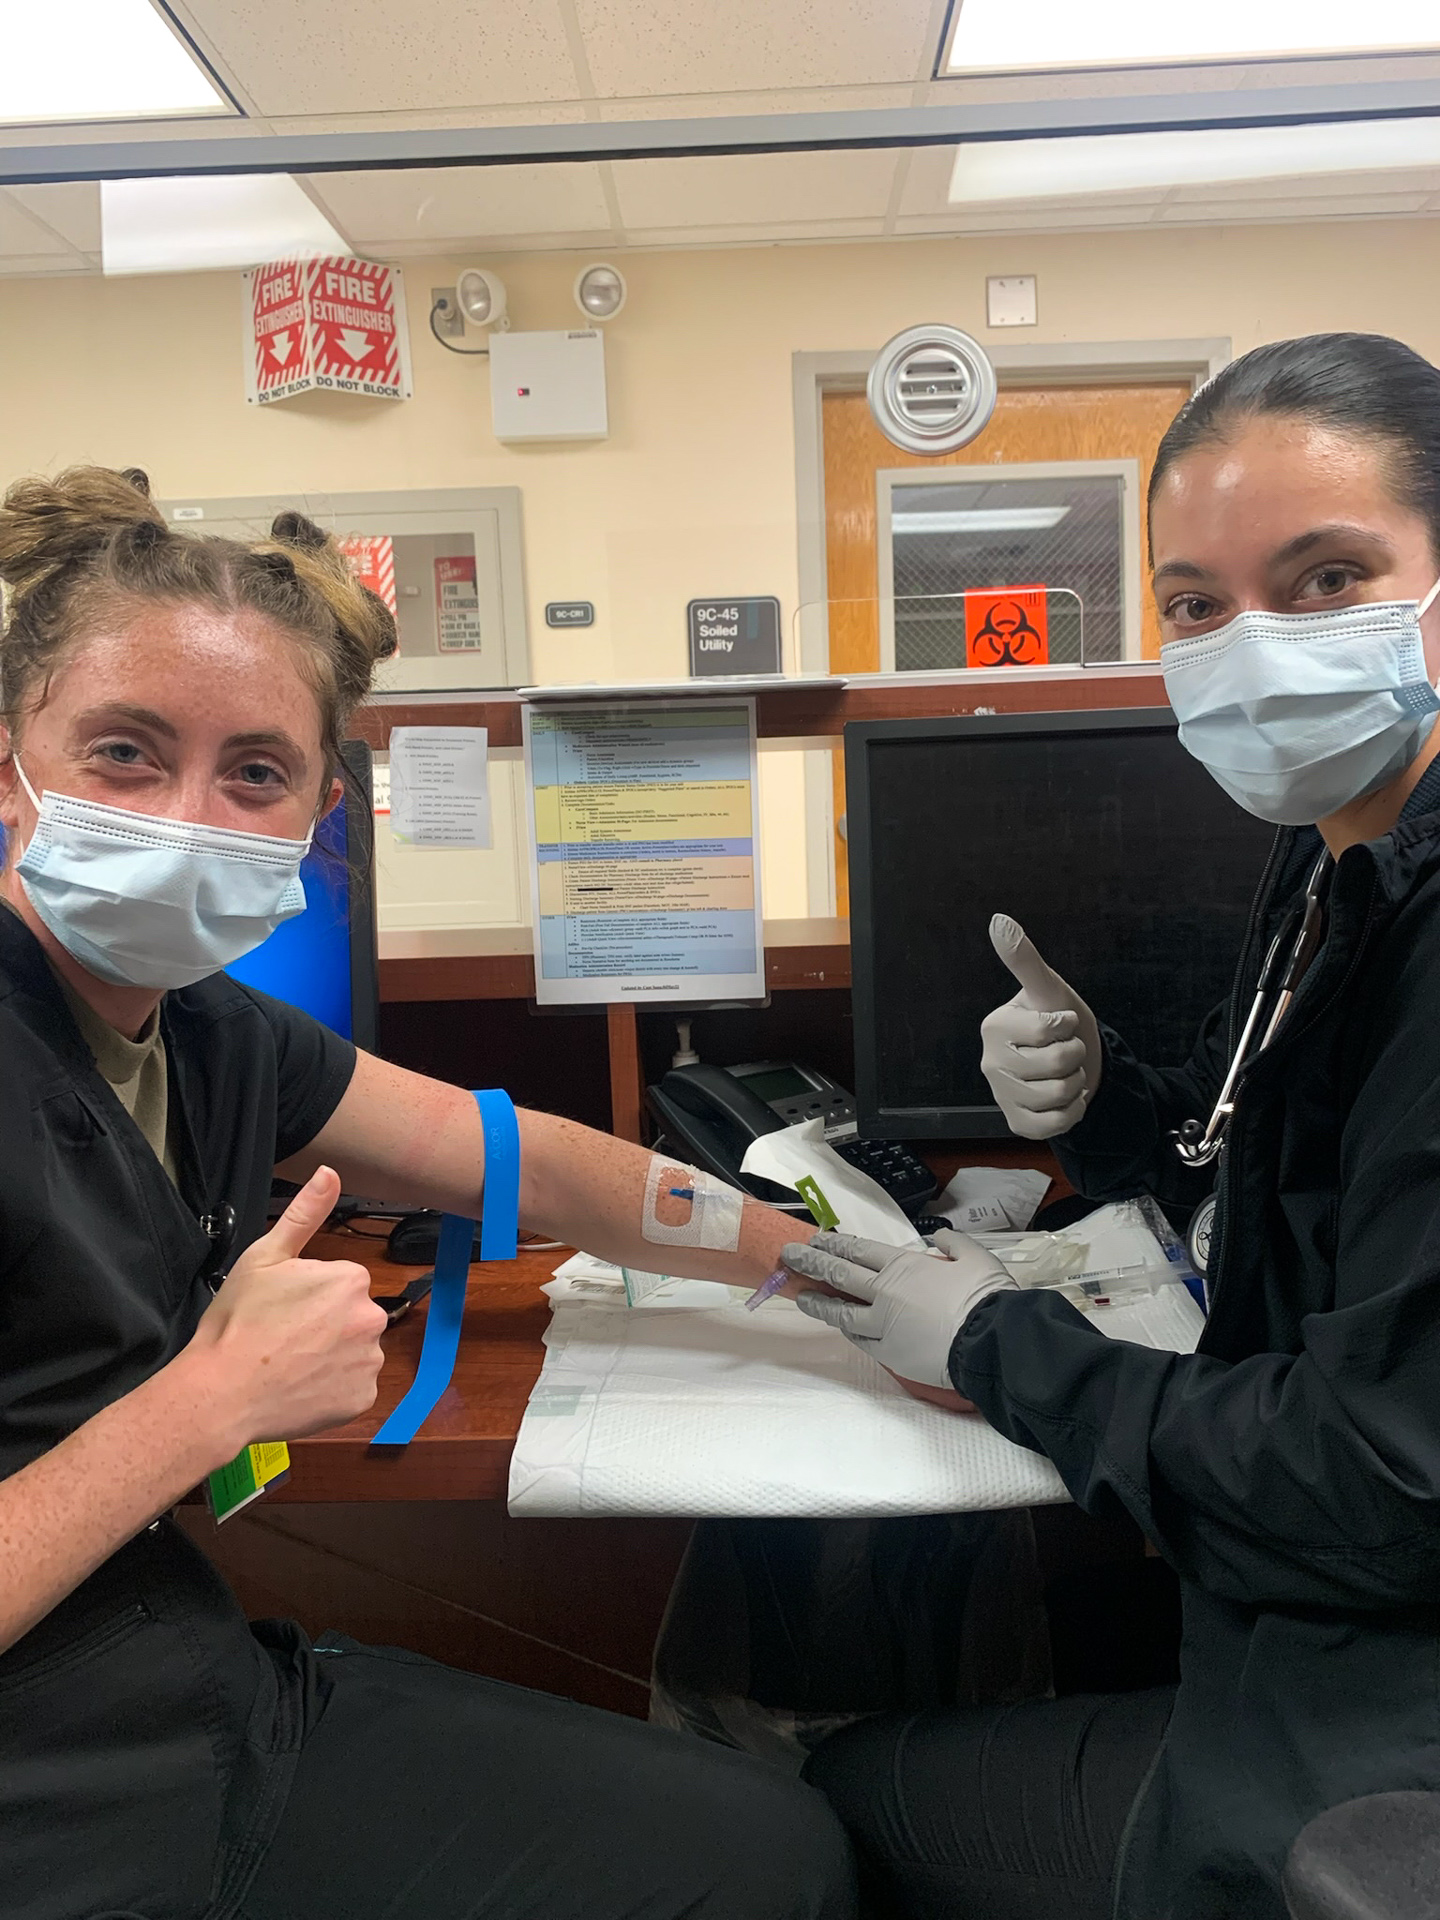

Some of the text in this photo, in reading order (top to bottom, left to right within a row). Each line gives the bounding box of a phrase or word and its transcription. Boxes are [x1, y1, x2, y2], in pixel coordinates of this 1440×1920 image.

[263, 273, 294, 307] FIRE
[325, 272, 377, 304] FIRE
[255, 299, 305, 337] EXTINGUISHER
[313, 299, 393, 332] EXTINGUISHER
[258, 378, 312, 403] DO NOT BLOCK
[316, 376, 401, 397] DO NOT BLOCK
[697, 607, 739, 622] 9C-45
[699, 624, 738, 637] Soiled
[699, 638, 733, 652] Utility
